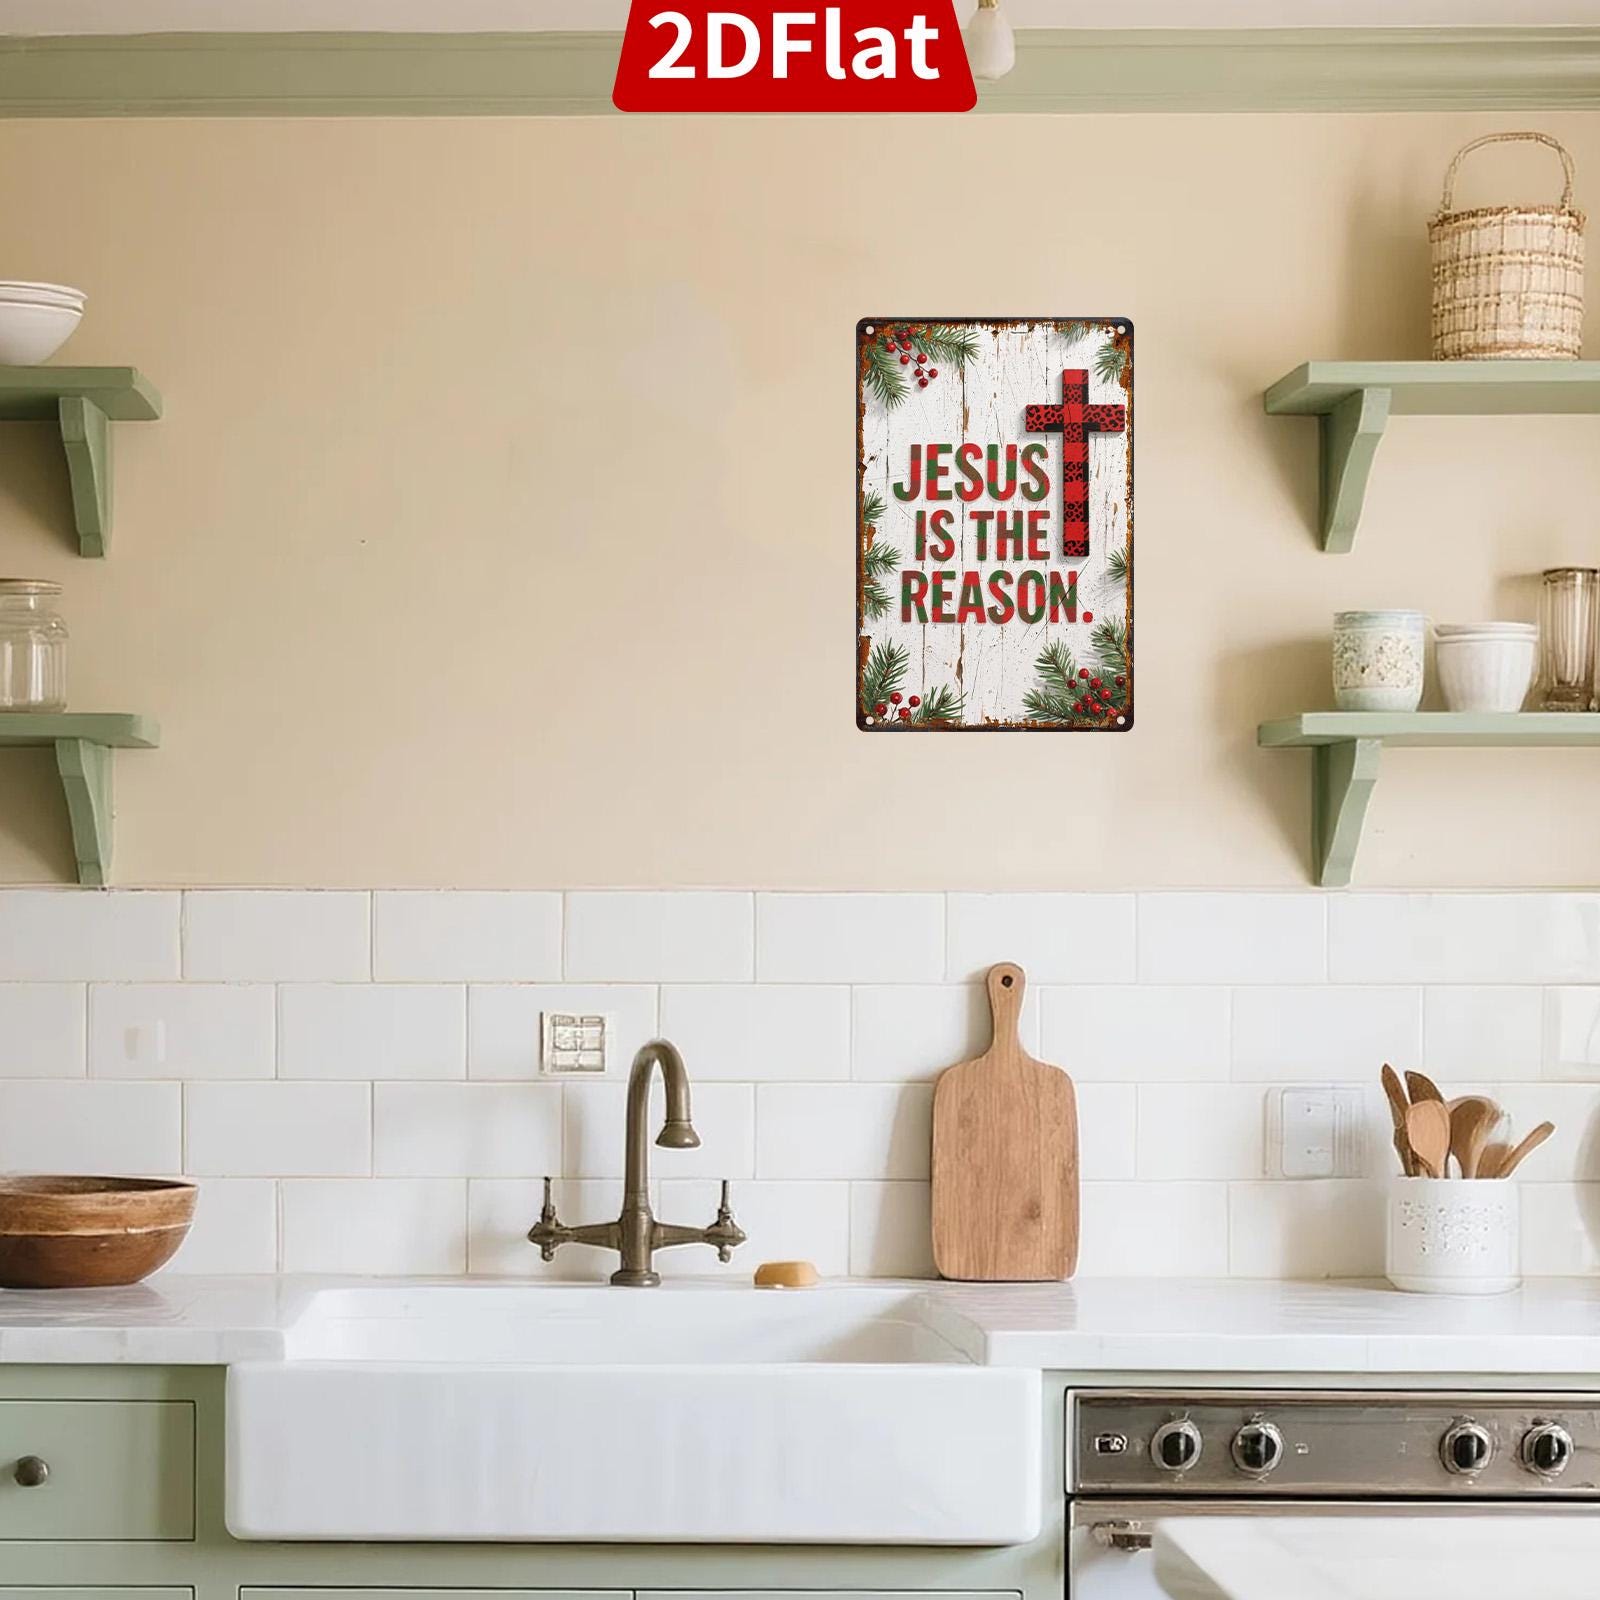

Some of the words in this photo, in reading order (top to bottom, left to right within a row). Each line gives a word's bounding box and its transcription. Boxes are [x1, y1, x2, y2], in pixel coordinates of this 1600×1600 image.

[893, 443, 1050, 501] JESUS
[915, 509, 955, 561] IS
[969, 510, 1050, 561] THE
[901, 569, 1093, 624] REASON.
